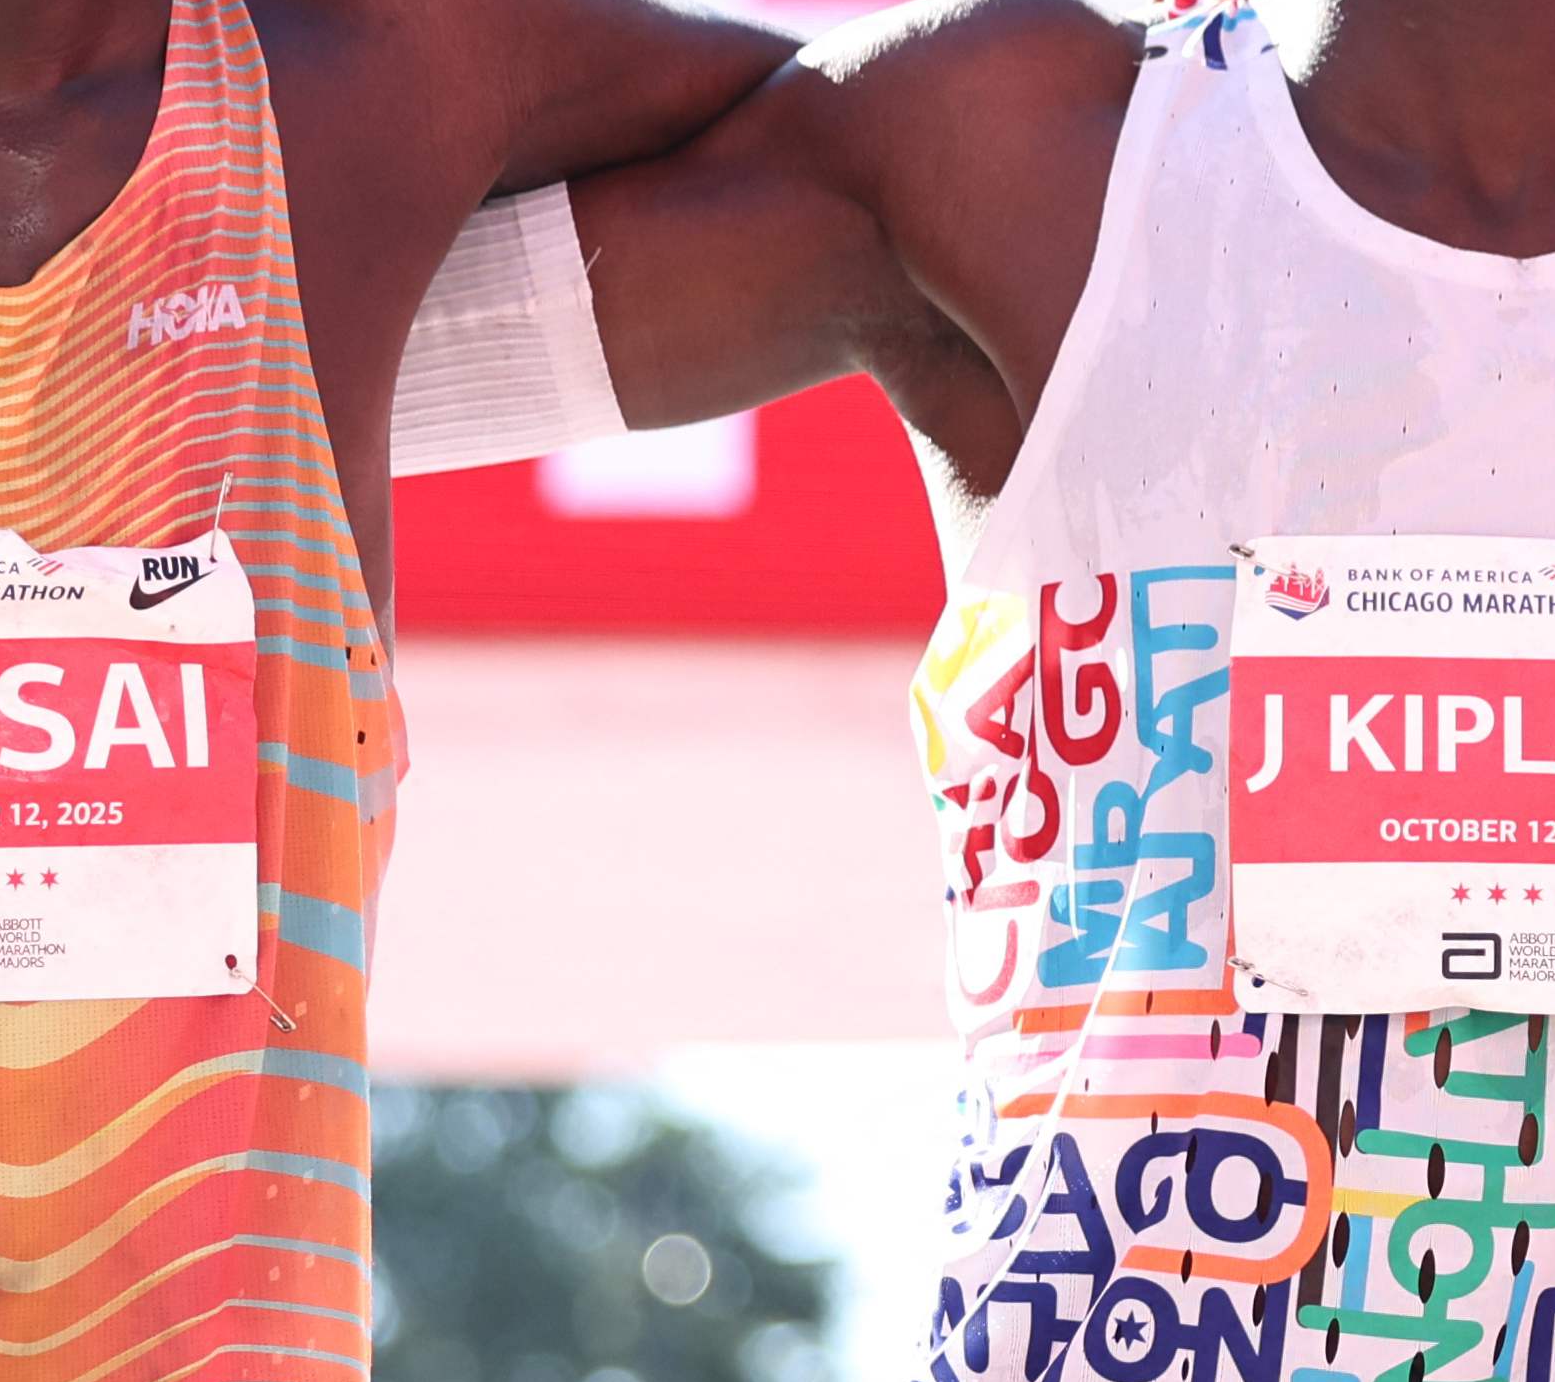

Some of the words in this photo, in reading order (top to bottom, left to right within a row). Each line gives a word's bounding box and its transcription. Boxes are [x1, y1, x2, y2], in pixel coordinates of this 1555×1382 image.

[126, 283, 247, 351] HOKA
[142, 555, 201, 582] RUN
[1347, 568, 1404, 583] BANK
[1409, 568, 1435, 583] OF
[1439, 569, 1534, 584] AMERICA
[1345, 590, 1453, 614] CHICAGO
[1245, 693, 1284, 795] J
[9, 803, 49, 830] 12,
[56, 800, 124, 826] 2025
[1379, 818, 1517, 843] OCTOBER
